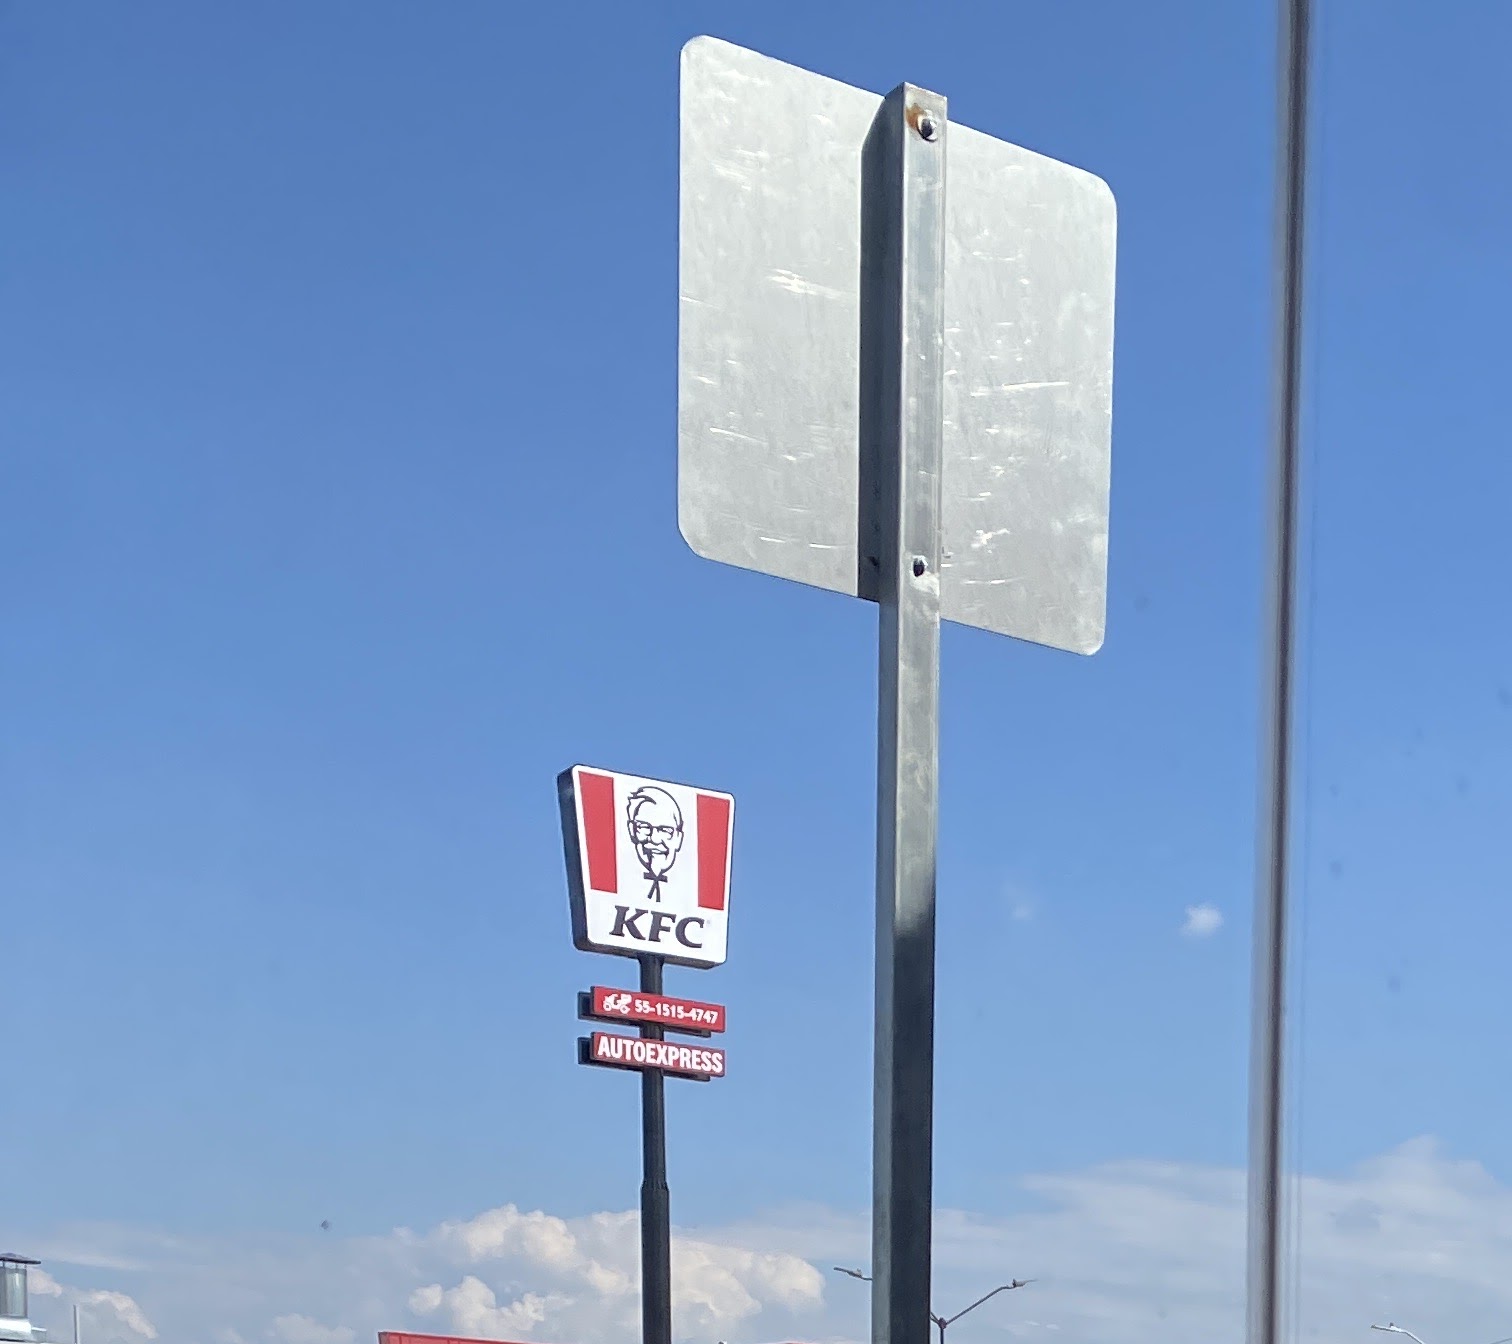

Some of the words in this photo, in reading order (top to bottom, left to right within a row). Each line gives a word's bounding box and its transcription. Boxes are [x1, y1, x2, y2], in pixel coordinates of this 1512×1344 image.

[609, 905, 705, 948] KFC
[635, 999, 719, 1024] 55-1515-4747
[597, 1036, 724, 1073] AUTOEXPRESS
